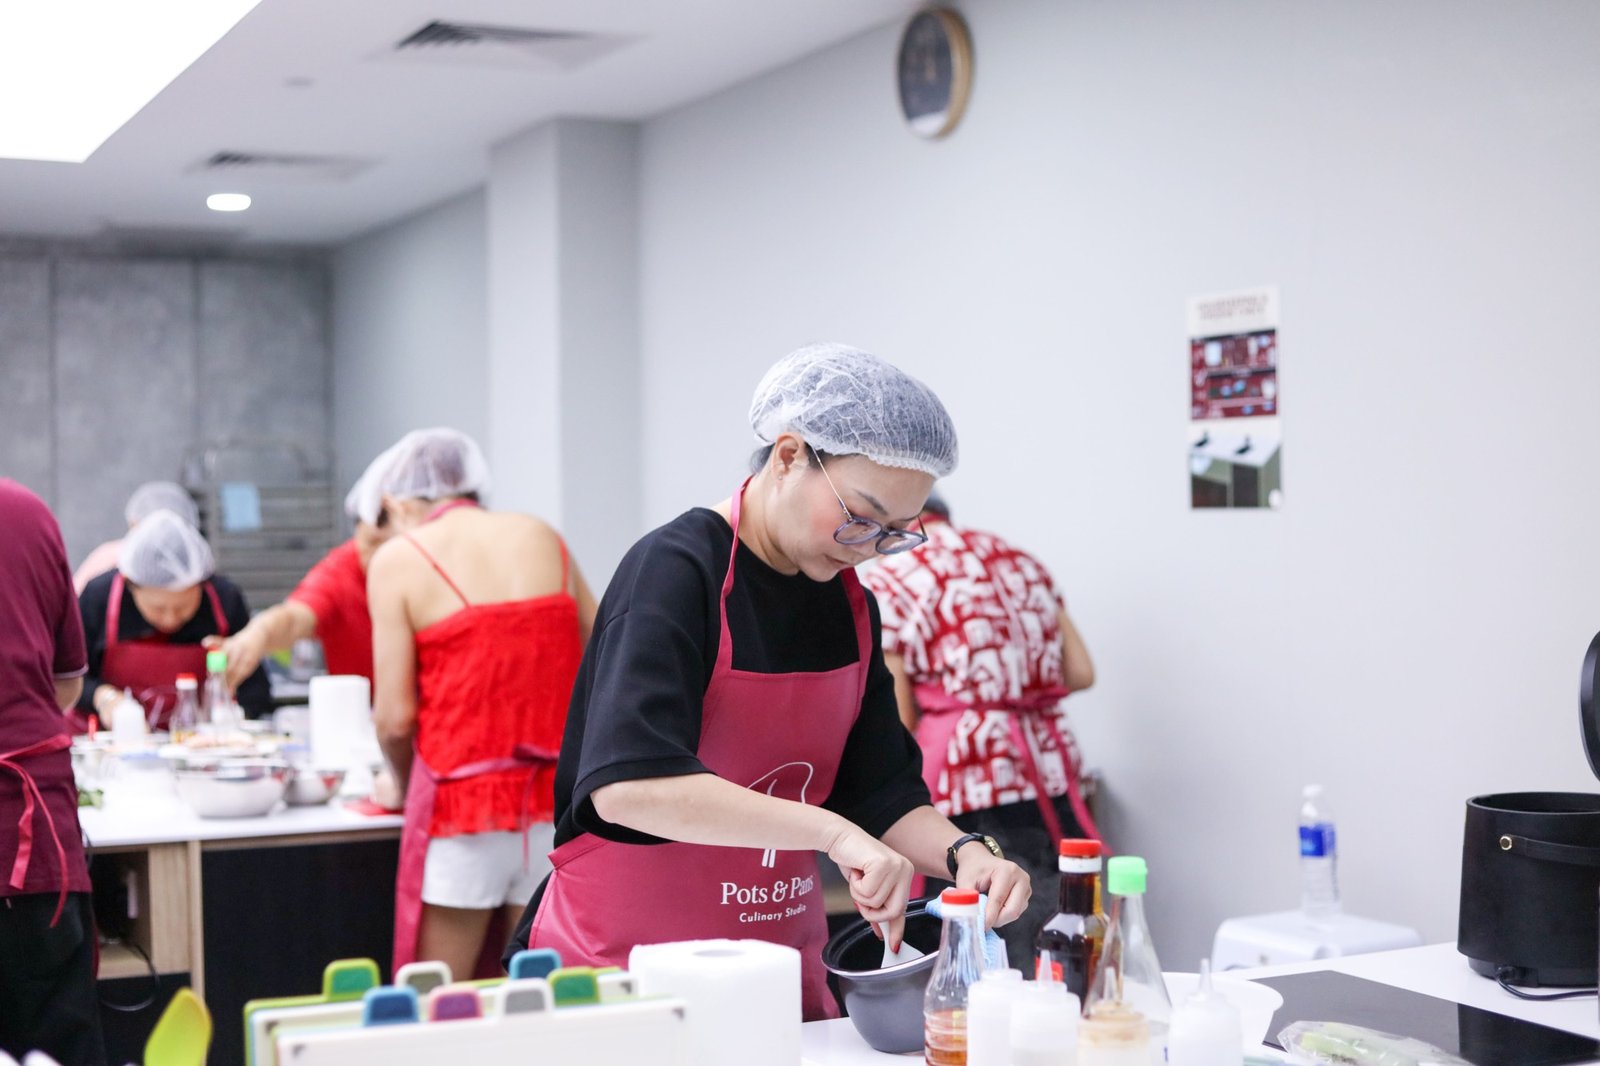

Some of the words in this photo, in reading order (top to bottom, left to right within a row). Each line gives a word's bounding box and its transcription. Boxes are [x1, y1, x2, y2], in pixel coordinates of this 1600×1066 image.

[720, 882, 768, 905] Pots
[772, 881, 788, 902] &
[789, 876, 814, 899] Pans
[739, 911, 783, 923] Culinary
[785, 903, 807, 917] Studio
